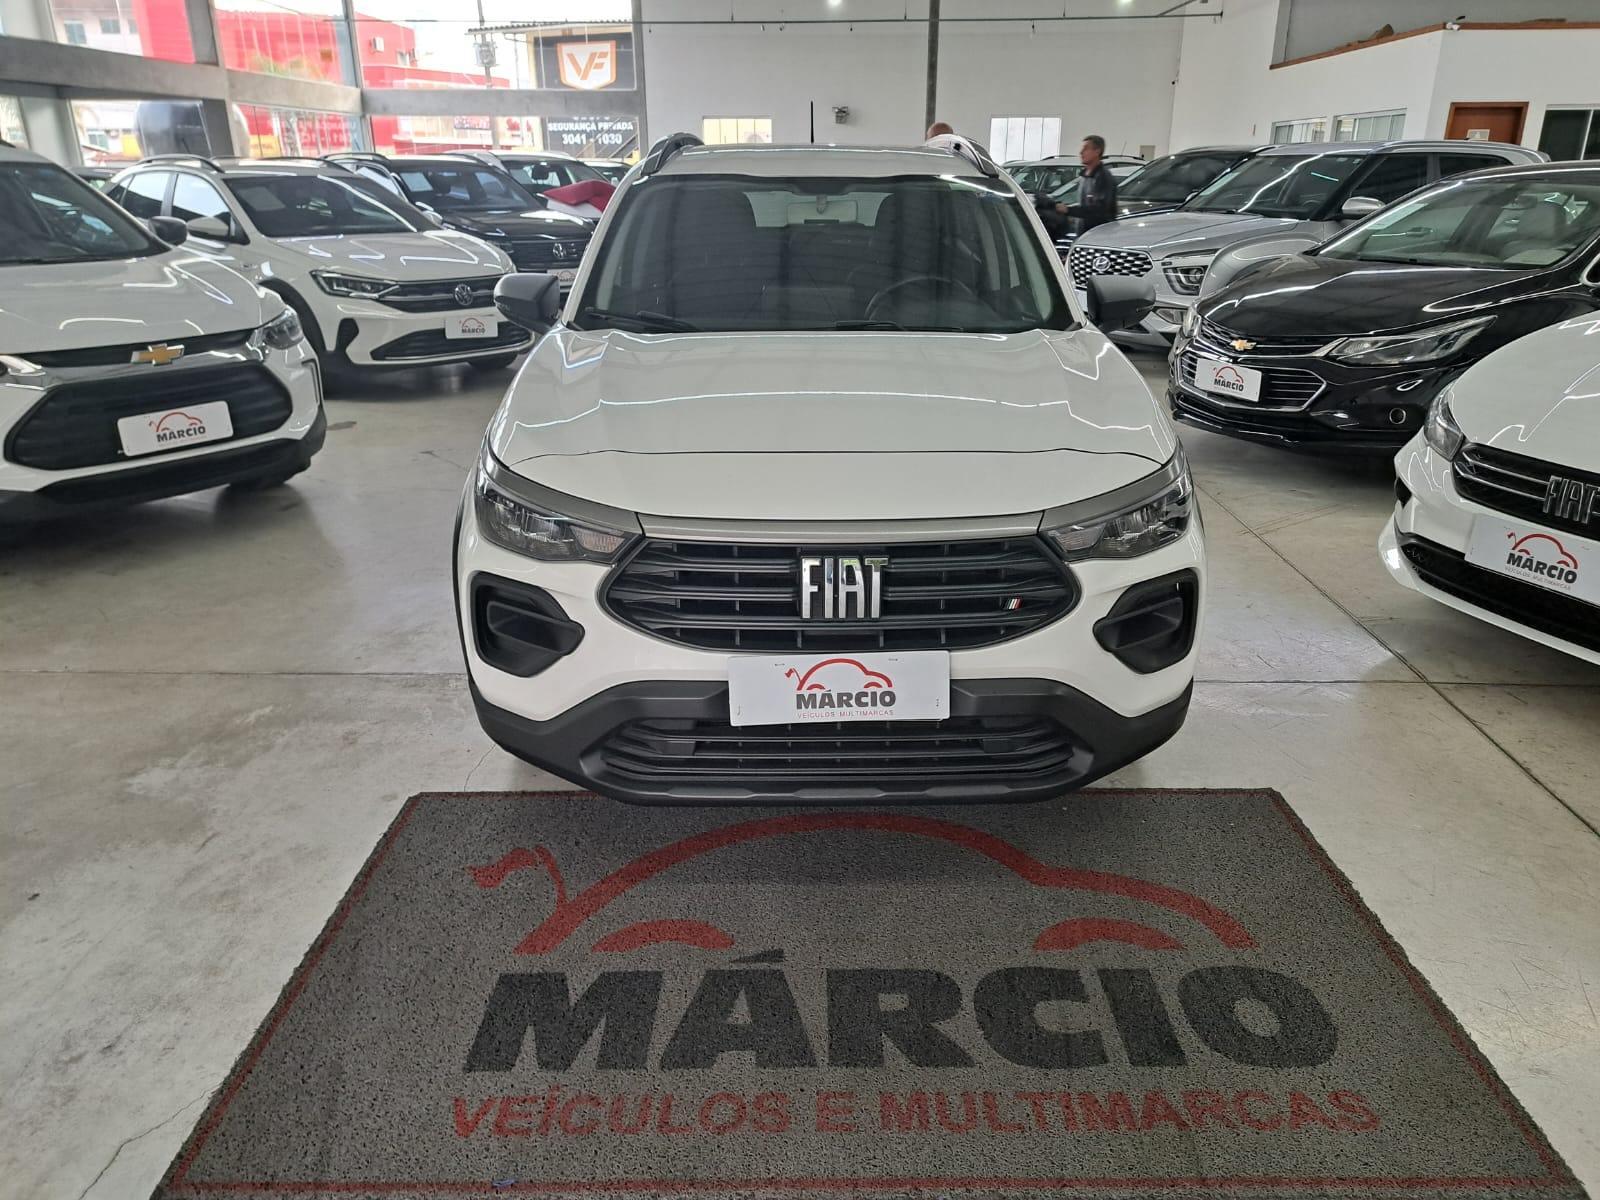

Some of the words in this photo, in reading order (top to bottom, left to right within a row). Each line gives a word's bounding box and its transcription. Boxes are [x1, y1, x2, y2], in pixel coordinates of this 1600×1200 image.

[566, 52, 608, 80] VF
[562, 134, 587, 145] 3041
[1542, 474, 1600, 524] FIAT
[801, 556, 889, 619] FIAT
[796, 689, 897, 710] MÁRCIO
[839, 709, 894, 718] MULTIMARCAS
[463, 947, 1339, 1073] MÁRCIO
[453, 1083, 792, 1138] VEÍCULOS
[815, 1090, 858, 1133] E
[878, 1089, 1381, 1134] MULTIMARCAS
